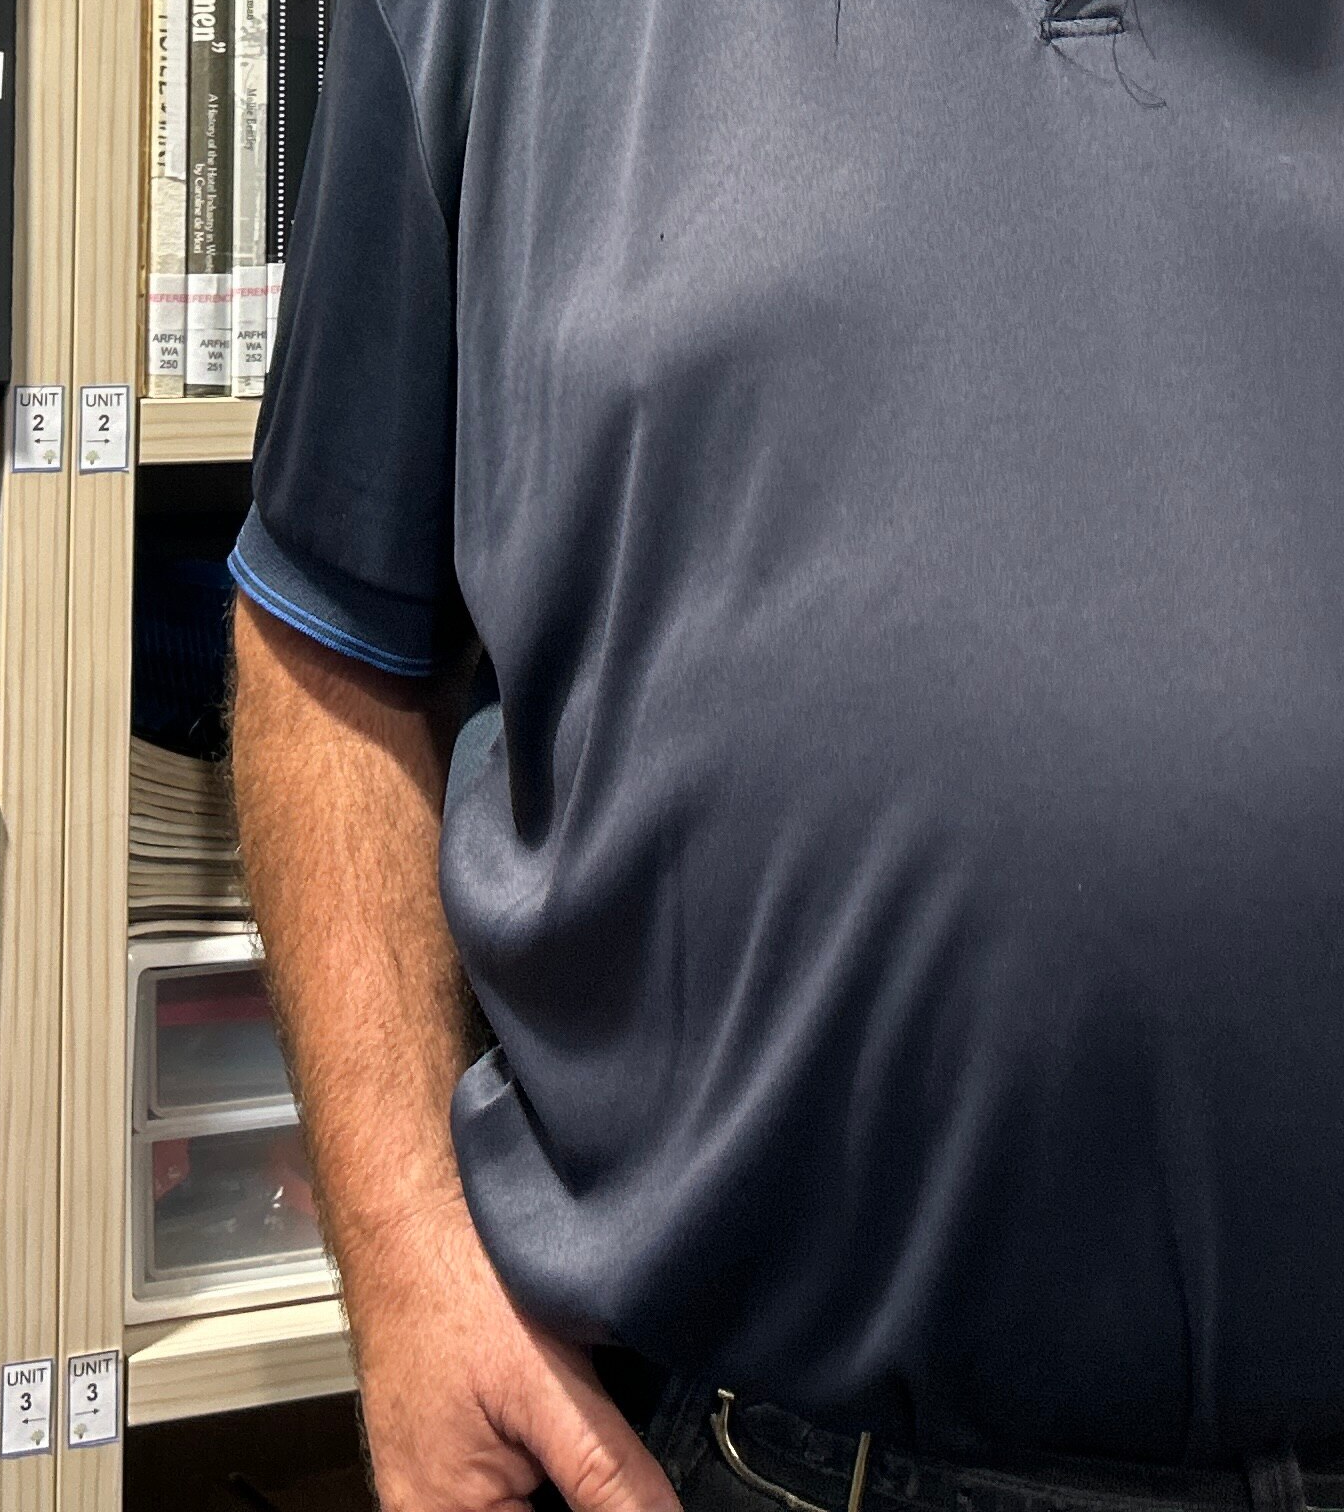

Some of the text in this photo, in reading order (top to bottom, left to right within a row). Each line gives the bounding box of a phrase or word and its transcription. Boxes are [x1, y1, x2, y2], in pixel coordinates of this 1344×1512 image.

[20, 393, 60, 407] UNIT
[85, 393, 124, 407] UNIT
[32, 415, 45, 431] 2
[98, 415, 110, 431] 2
[73, 1358, 112, 1377] UNIT
[7, 1367, 48, 1386] UNIT
[87, 1383, 98, 1401] 3
[21, 1392, 31, 1411] 3
